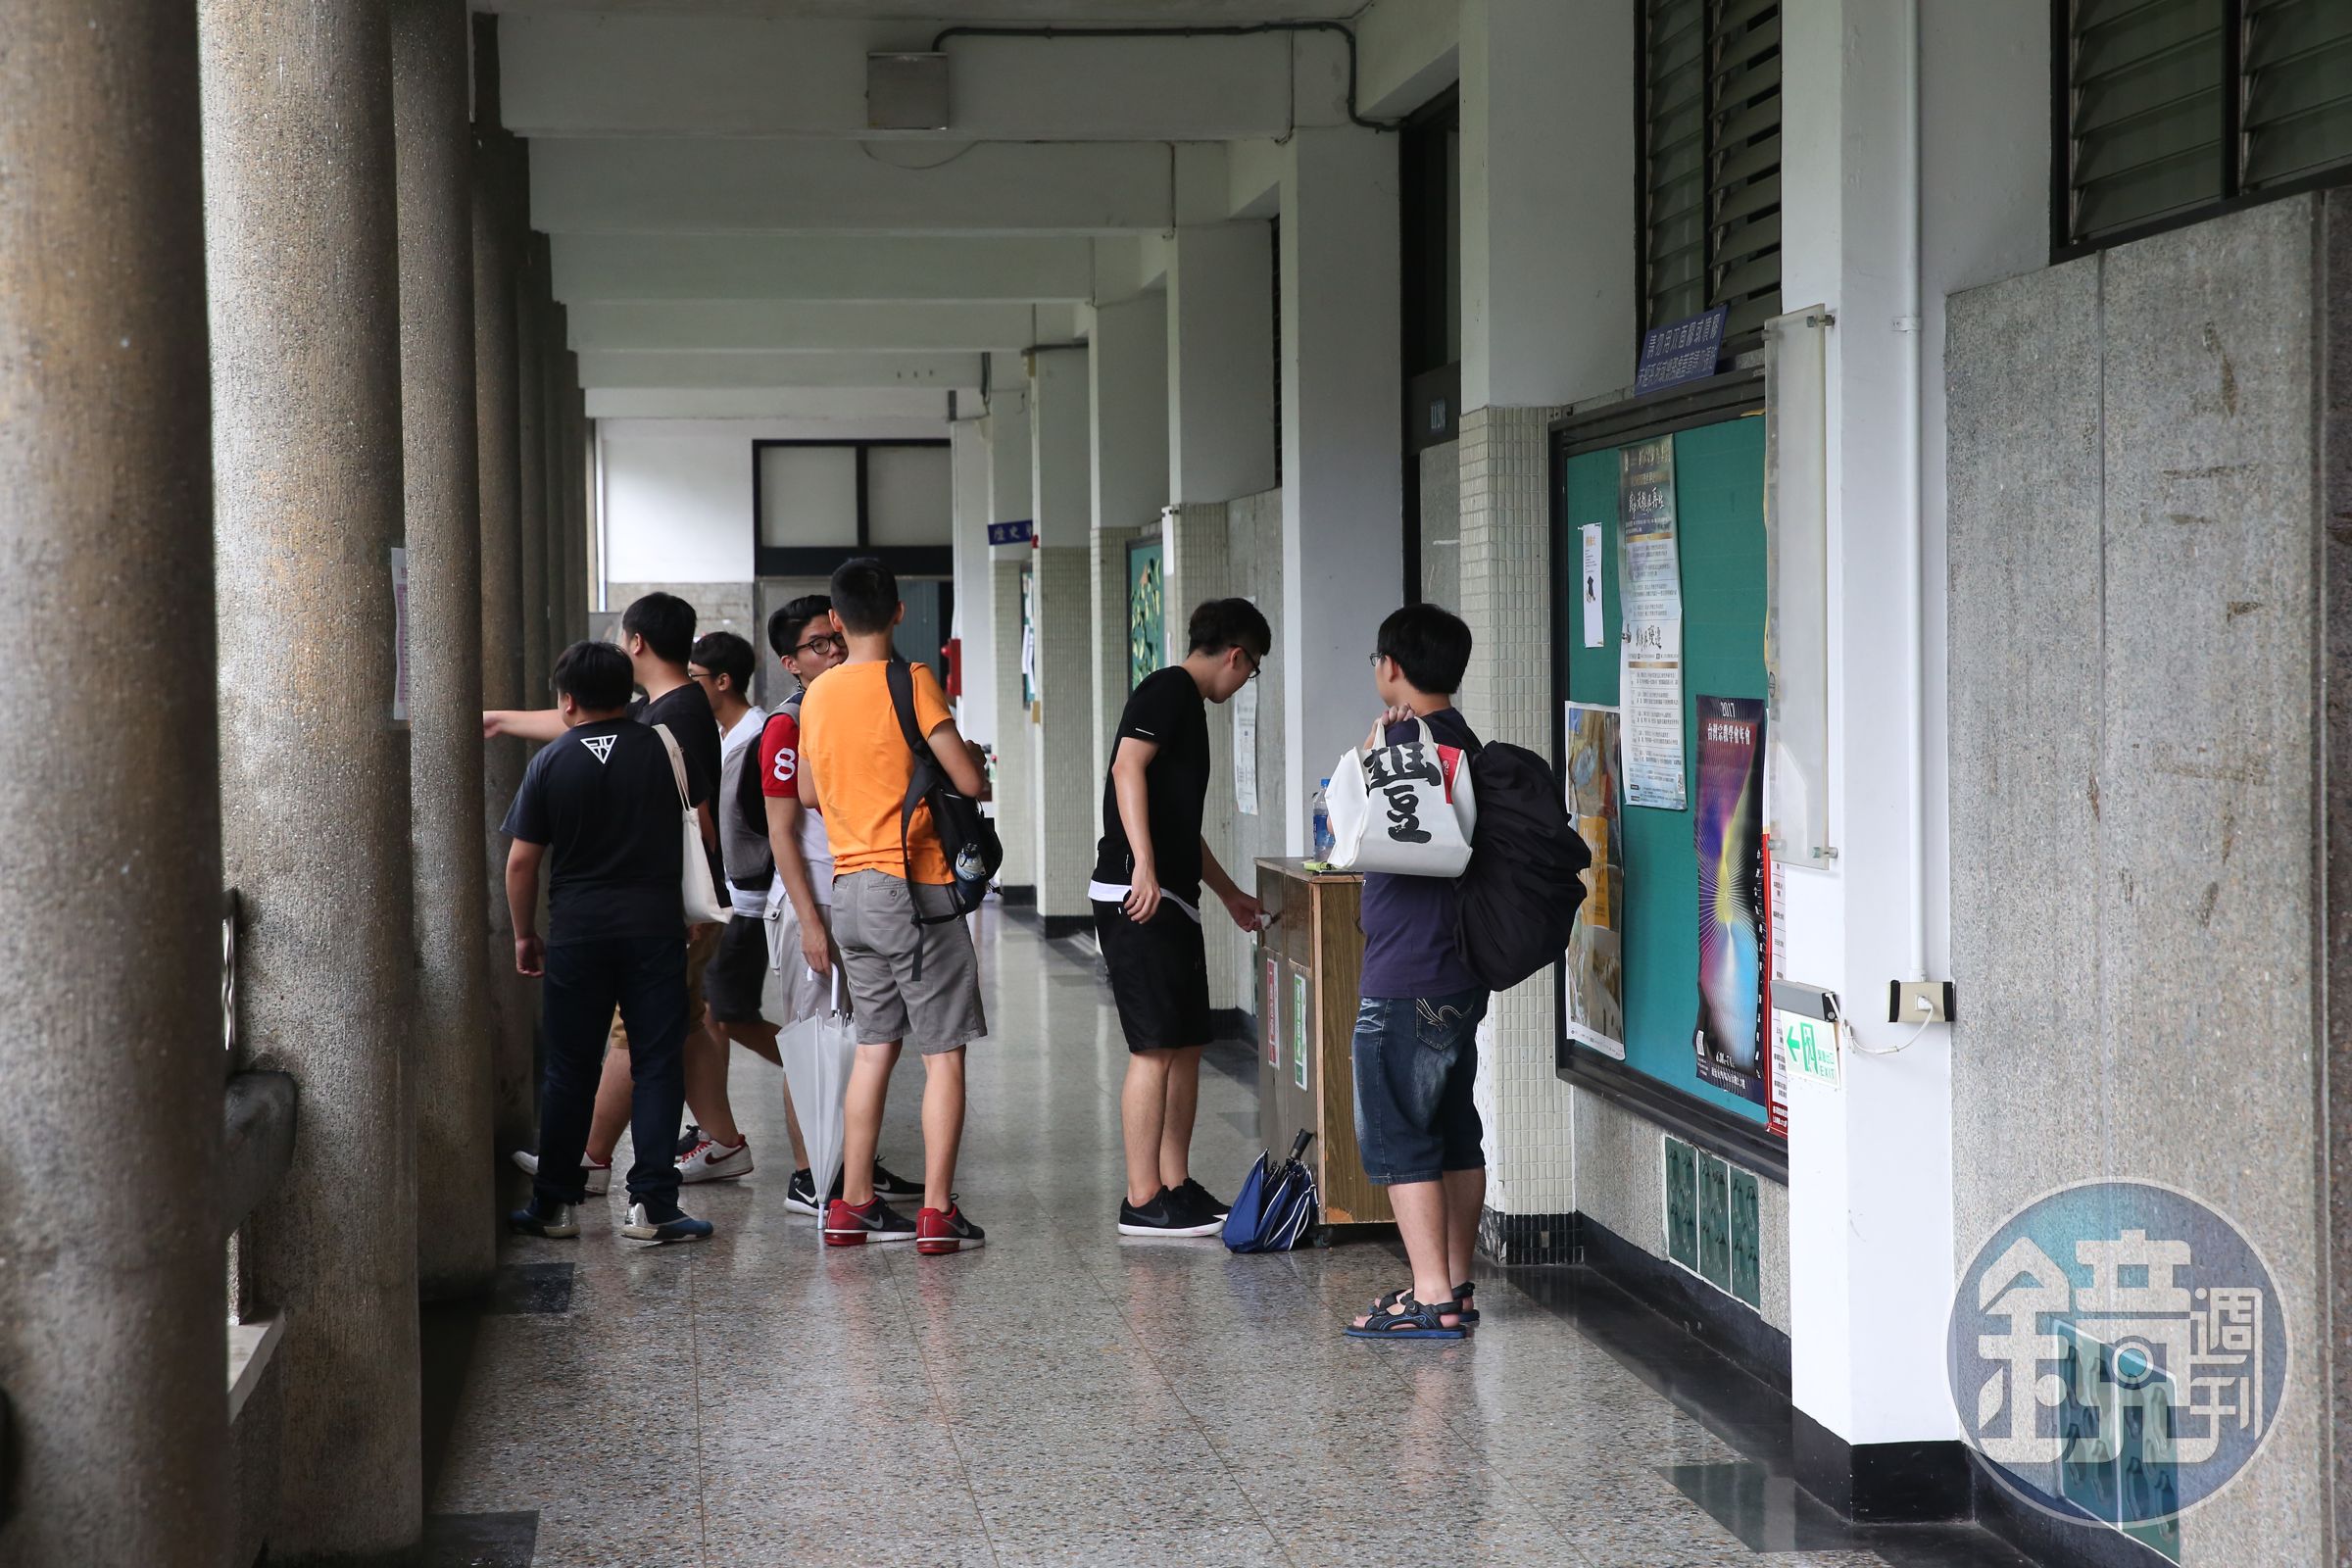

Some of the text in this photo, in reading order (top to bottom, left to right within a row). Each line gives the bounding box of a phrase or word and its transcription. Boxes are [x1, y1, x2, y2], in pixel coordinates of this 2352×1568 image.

[1720, 701, 1736, 718] 2017
[773, 747, 797, 781] 8
[1819, 1064, 1836, 1080] EXIT
